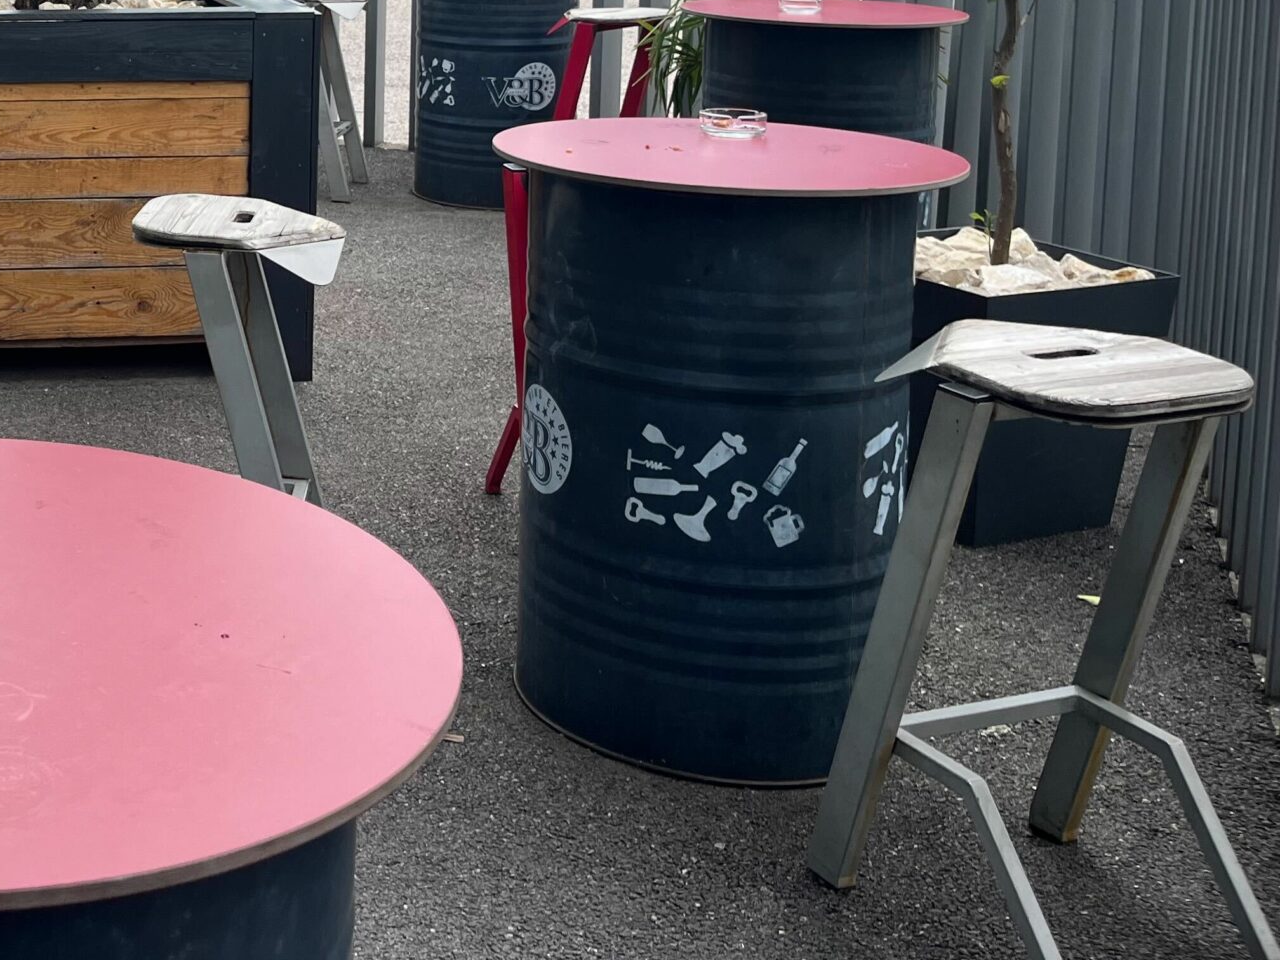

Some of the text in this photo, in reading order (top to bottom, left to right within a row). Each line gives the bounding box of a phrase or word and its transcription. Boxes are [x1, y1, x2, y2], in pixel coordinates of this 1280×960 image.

[481, 77, 544, 108] V&B
[546, 398, 557, 414] ET
[555, 423, 569, 481] BIERES
